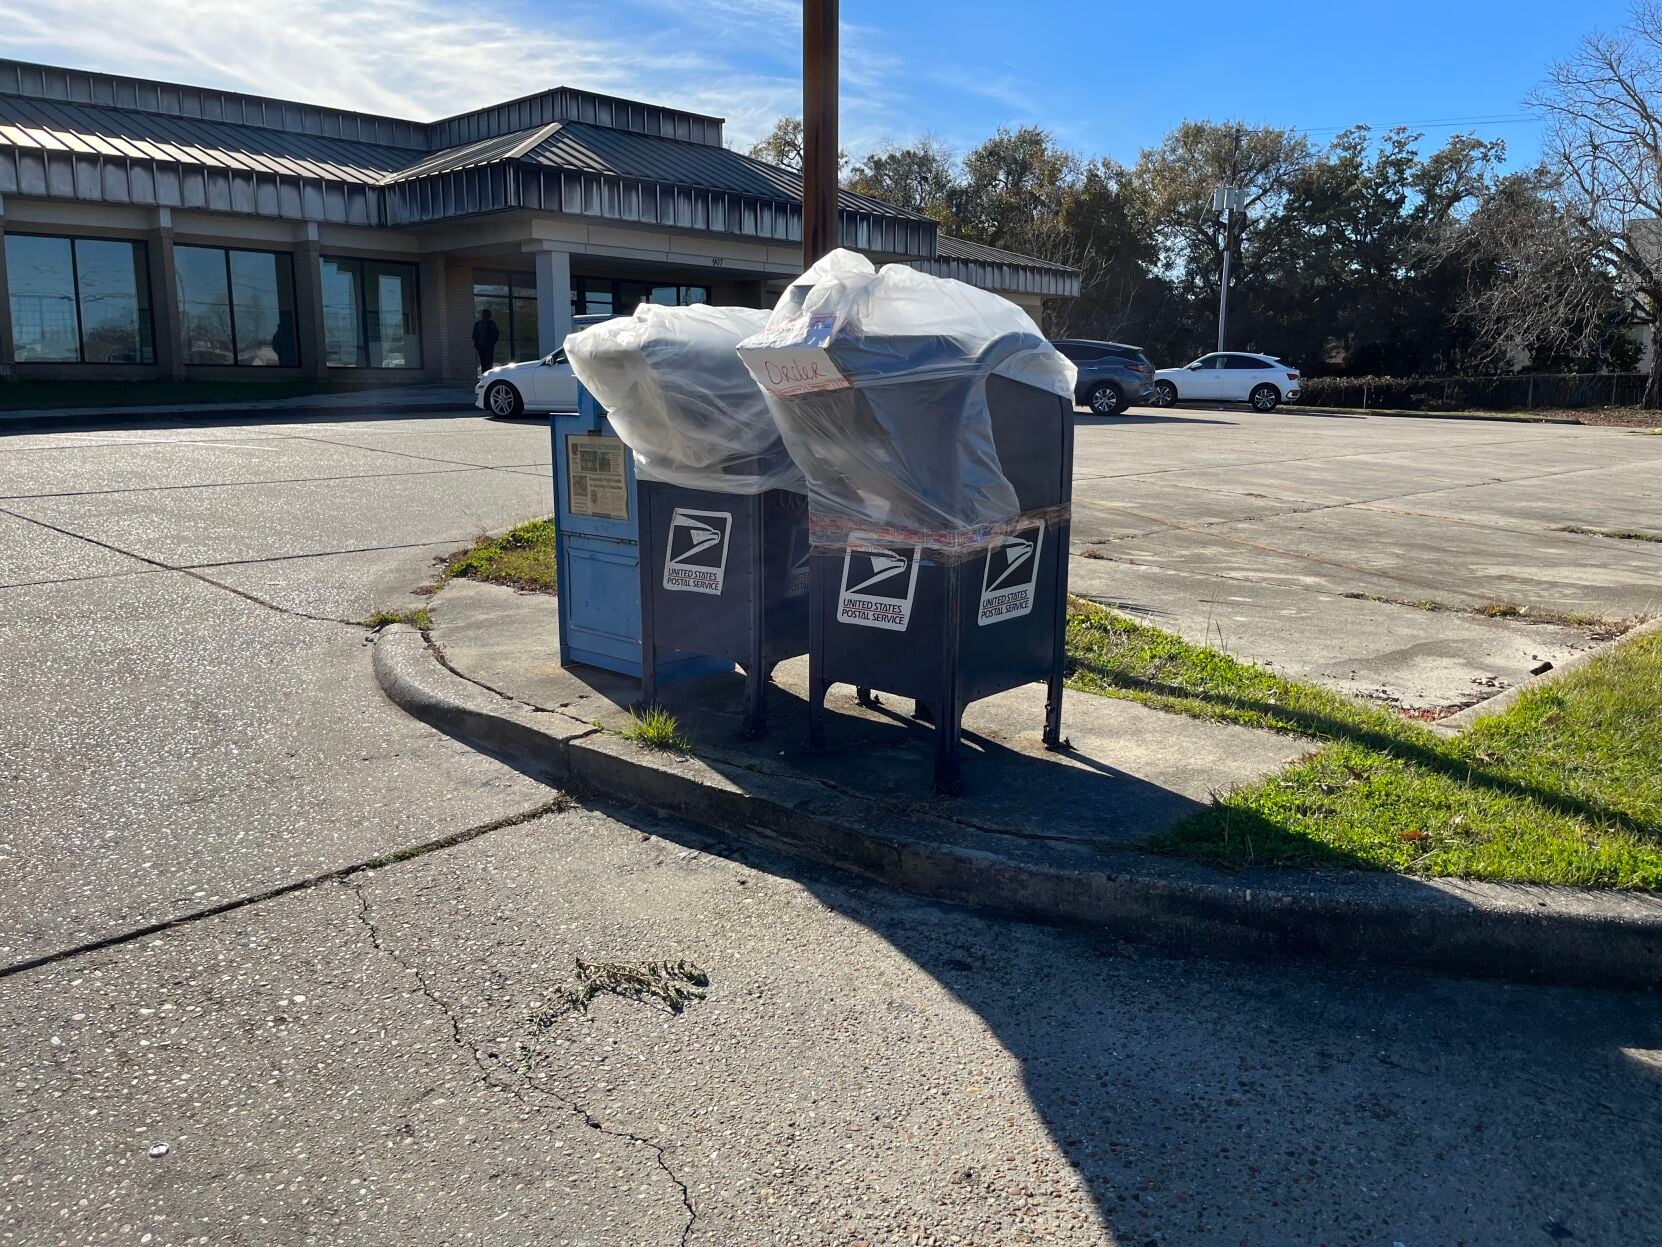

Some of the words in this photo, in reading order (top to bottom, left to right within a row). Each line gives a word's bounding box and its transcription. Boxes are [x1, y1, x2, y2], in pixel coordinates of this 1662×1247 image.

[668, 567, 693, 577] UNITED
[694, 571, 717, 580] STATES
[667, 577, 691, 586] POSTAL
[693, 580, 719, 590] SERVICE
[843, 598, 873, 609] UNITED
[874, 602, 902, 613] STATES
[983, 595, 1006, 608] UNITED
[1007, 589, 1028, 600] STATES
[841, 609, 871, 621] POSTAL
[872, 613, 904, 625] SERVICE
[981, 608, 1004, 619] POSTAL
[1005, 600, 1029, 613] SERVICE
